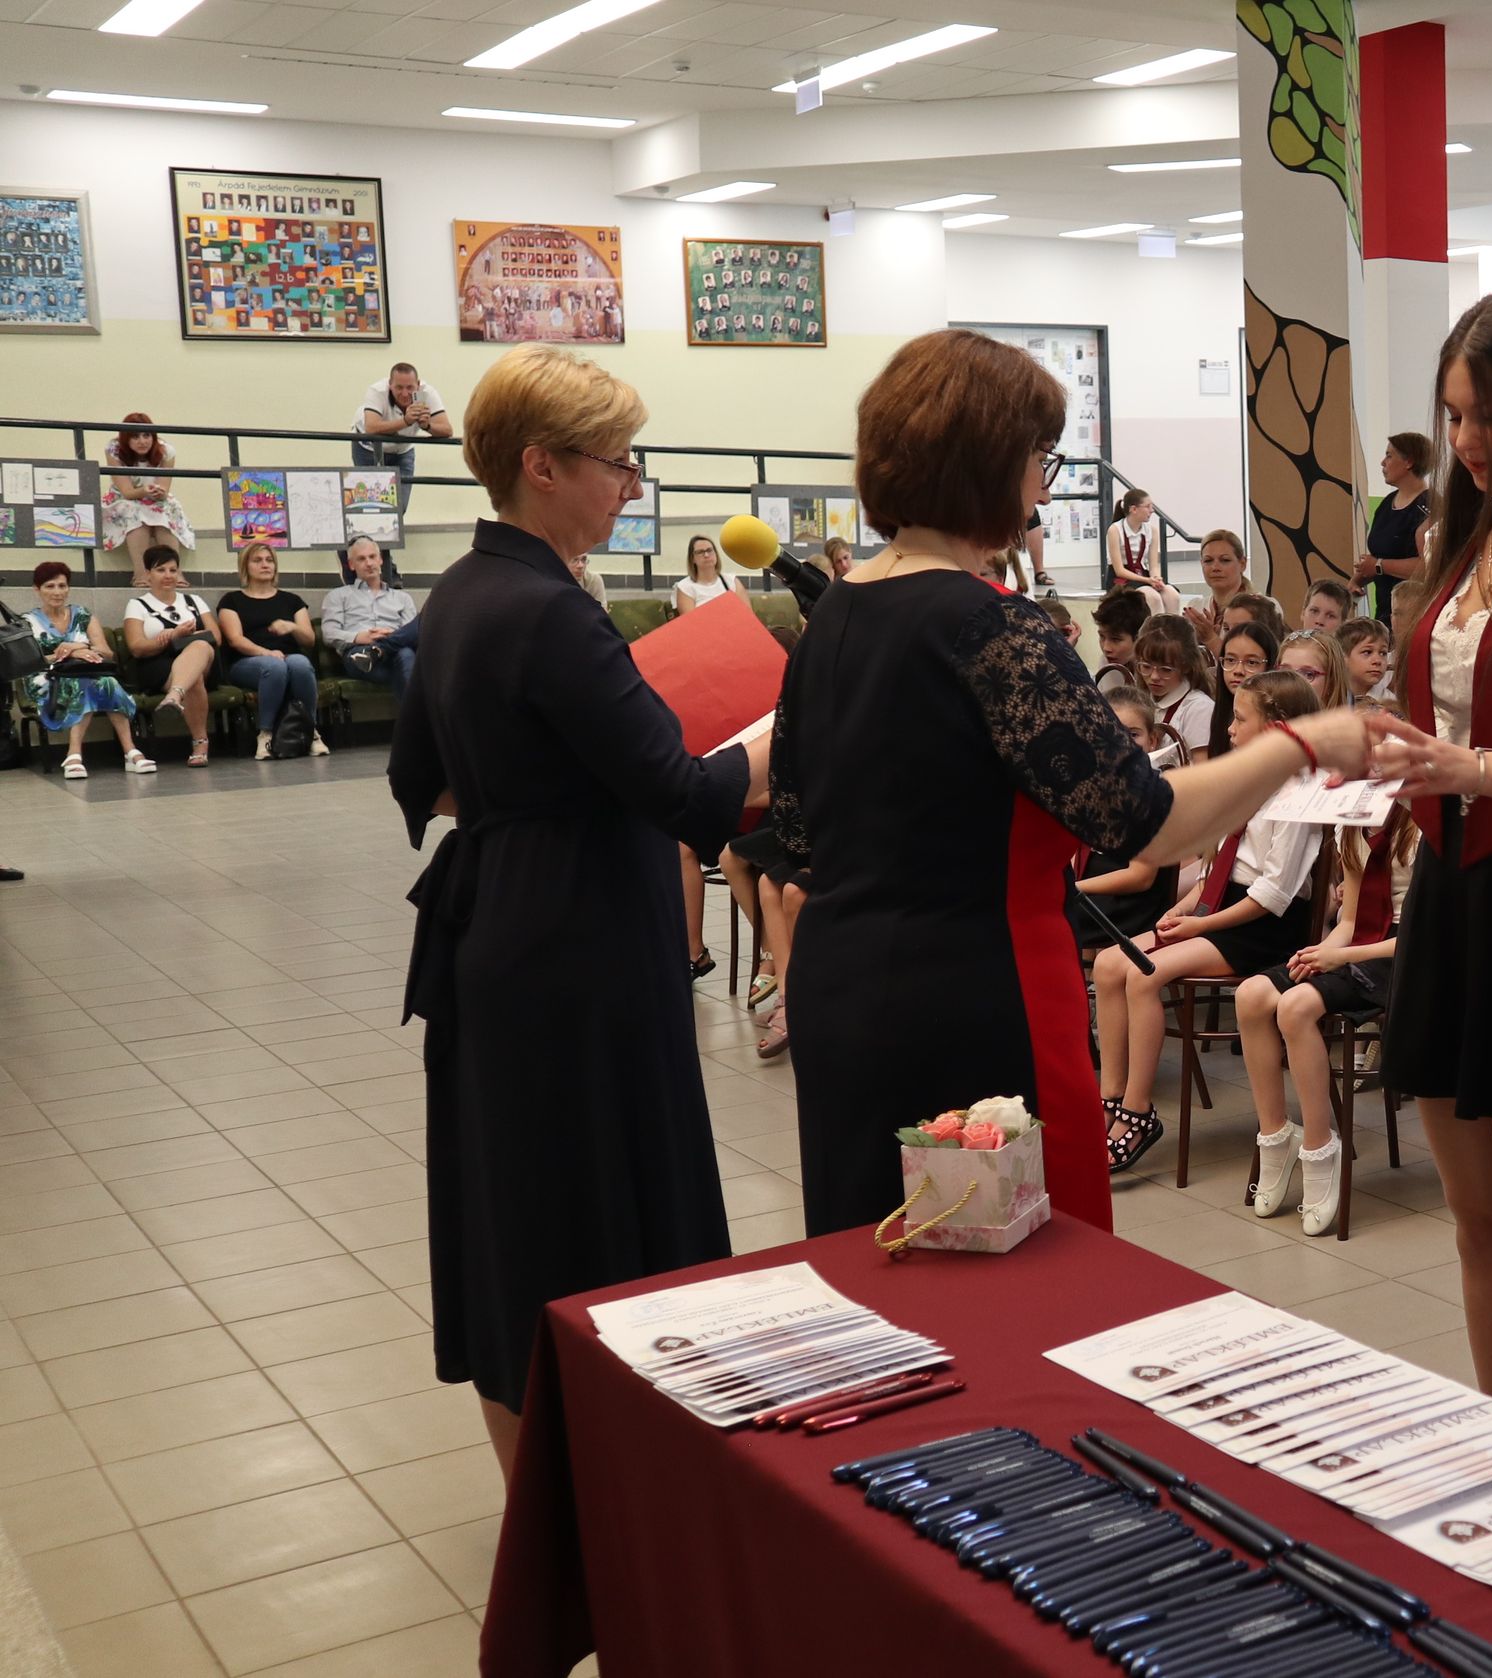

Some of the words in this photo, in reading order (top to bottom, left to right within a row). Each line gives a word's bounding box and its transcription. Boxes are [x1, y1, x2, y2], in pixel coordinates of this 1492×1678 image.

[217, 179, 246, 191] Árpád
[247, 181, 291, 193] Fejedelem
[293, 183, 340, 195] Gimnázium
[696, 1302, 835, 1342] EMLÉKLAP
[1172, 1322, 1294, 1369] EMLÉKLAP
